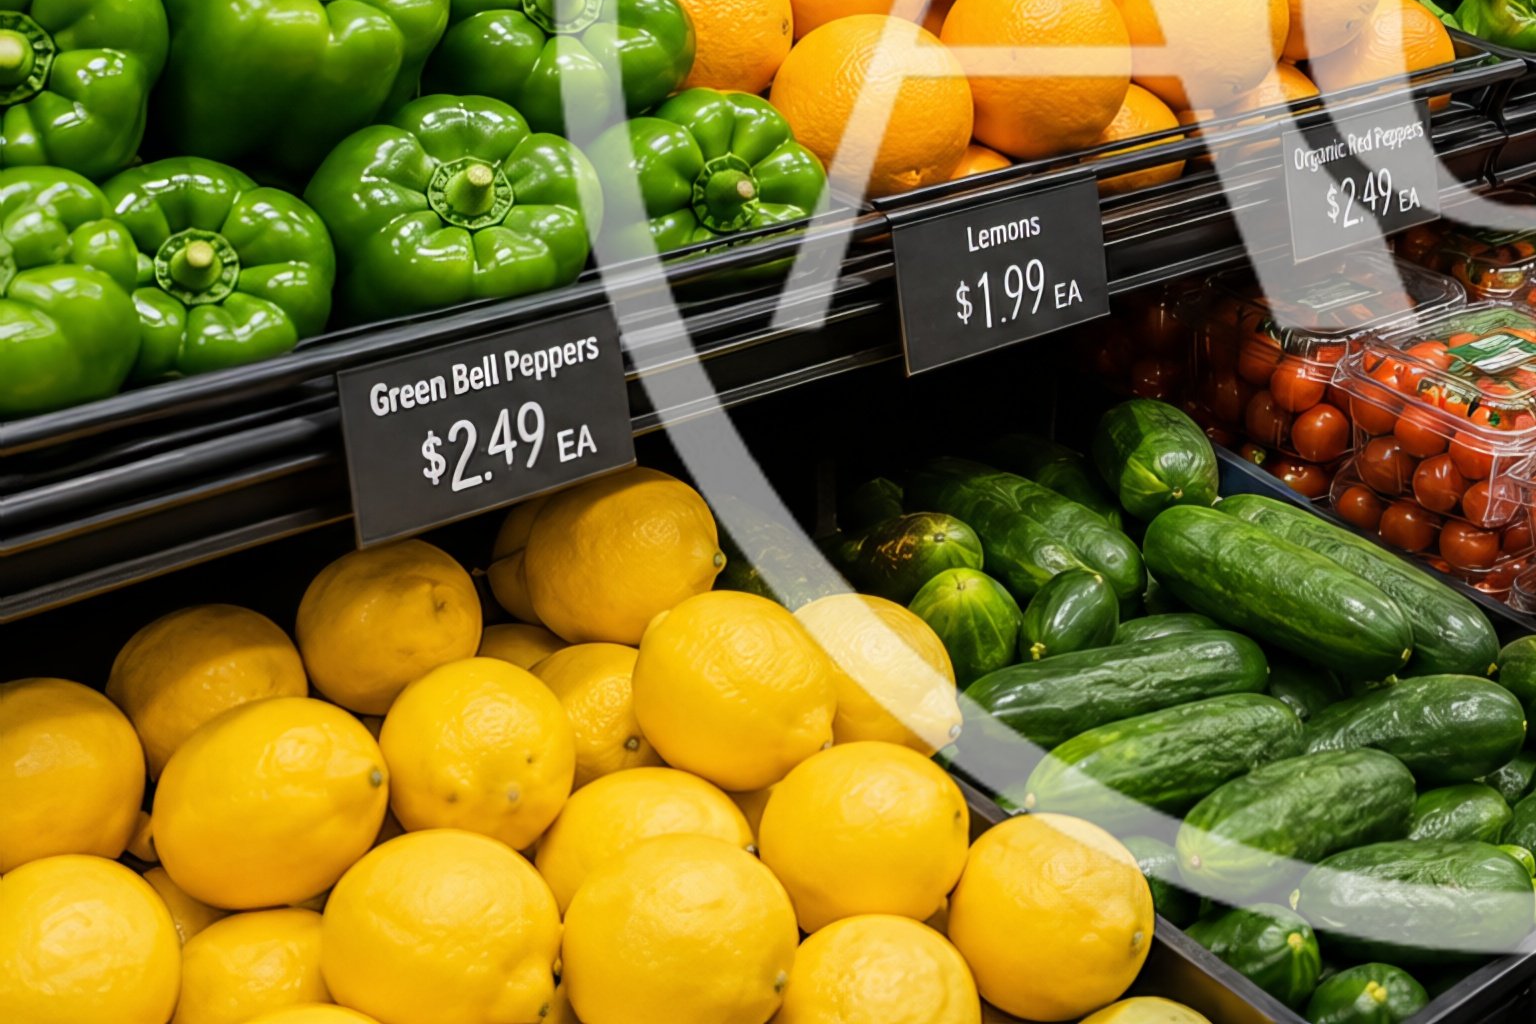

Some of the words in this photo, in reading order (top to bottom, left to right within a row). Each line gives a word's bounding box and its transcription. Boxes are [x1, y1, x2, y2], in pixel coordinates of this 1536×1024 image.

[1294, 139, 1347, 173] Organic
[1348, 129, 1372, 156] Red
[1374, 121, 1424, 150] Peppers
[1326, 167, 1392, 228] $2.49
[1398, 186, 1421, 212] EA
[967, 216, 1040, 252] Lemons
[956, 258, 1044, 328] $1.99
[1054, 279, 1083, 309] EA
[370, 375, 447, 416] Green
[452, 354, 500, 395] Bell
[504, 336, 599, 381] Peppers
[421, 401, 545, 492] $2.49
[557, 424, 597, 463] EA
